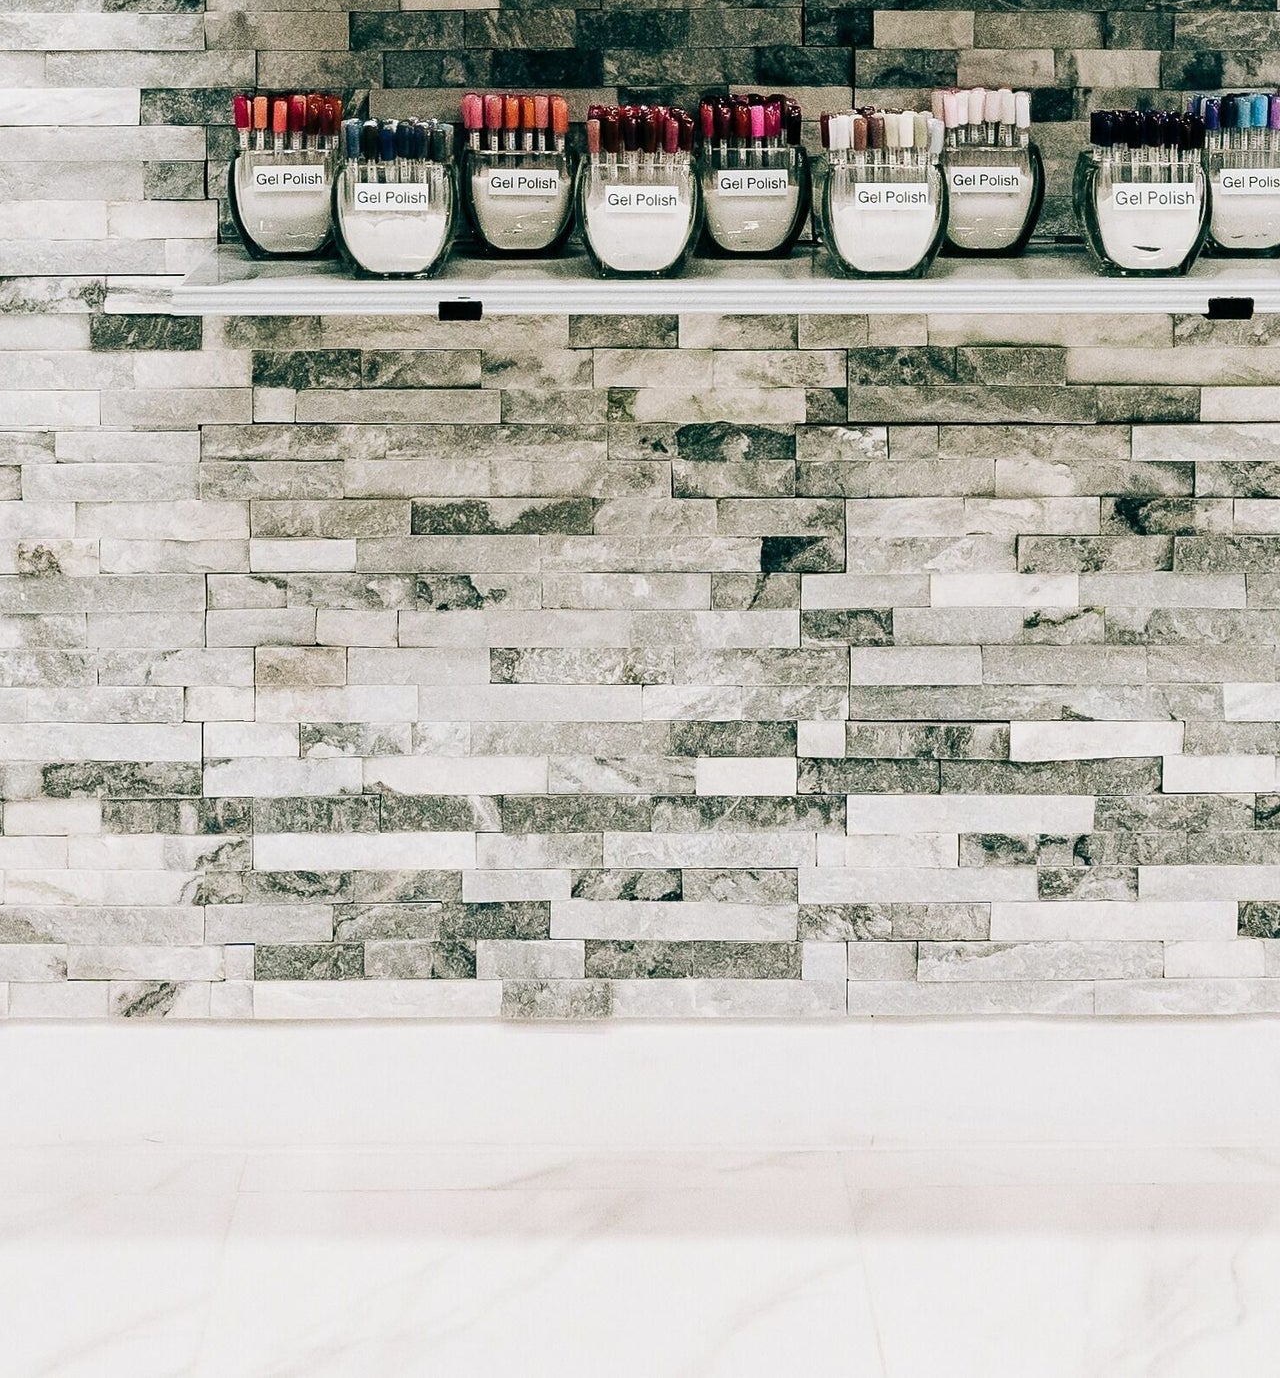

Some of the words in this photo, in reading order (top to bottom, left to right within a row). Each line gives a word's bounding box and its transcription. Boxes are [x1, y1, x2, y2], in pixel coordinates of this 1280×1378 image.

[255, 172, 279, 186] Gel
[282, 171, 324, 186] Polish
[489, 176, 514, 190] Gel
[517, 176, 558, 190] Polish
[719, 177, 744, 190] Gel
[747, 176, 787, 190] Polish
[952, 173, 976, 187] Gel
[979, 173, 1020, 187] Polish
[1222, 176, 1245, 189] Gel
[356, 190, 382, 205] Gel
[385, 190, 428, 205] Polish
[607, 193, 633, 206] Gel
[636, 193, 678, 207] Polish
[857, 190, 882, 204] Gel
[885, 189, 928, 204] Polish
[1115, 191, 1143, 205] Gel
[1147, 190, 1195, 206] Polish
